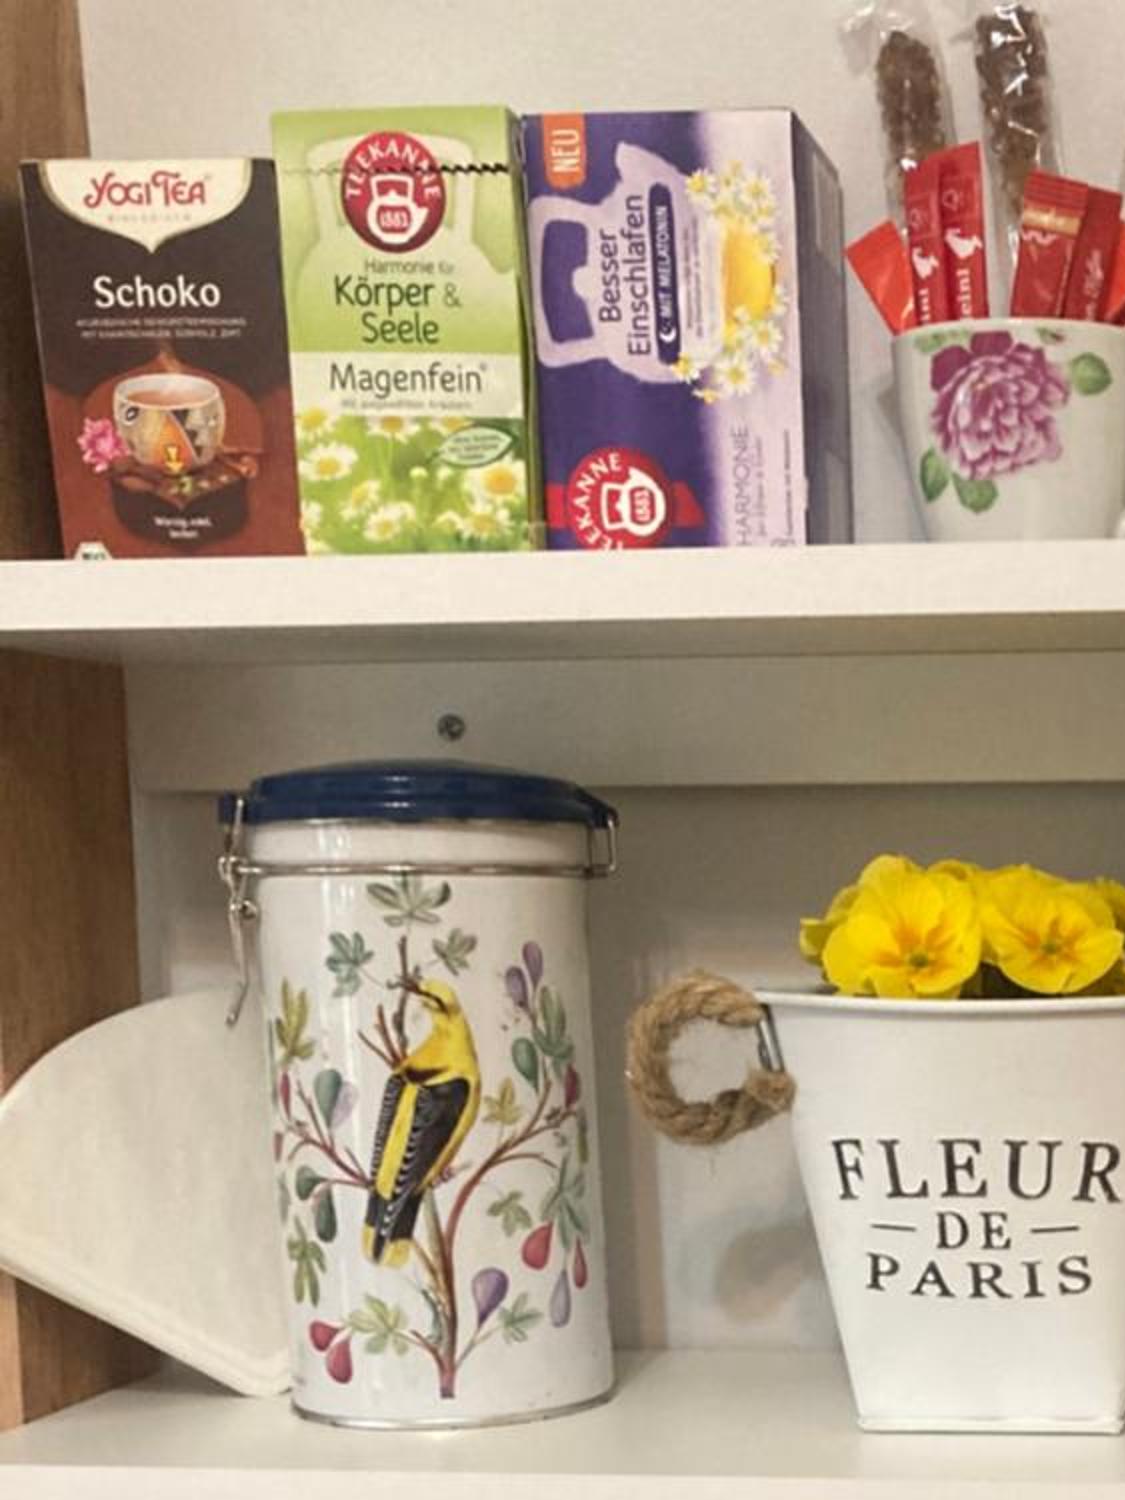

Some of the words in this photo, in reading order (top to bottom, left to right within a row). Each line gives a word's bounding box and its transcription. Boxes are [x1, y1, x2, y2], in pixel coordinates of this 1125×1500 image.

[344, 138, 442, 200] TEEKANNE
[551, 127, 581, 174] NEU
[83, 171, 152, 209] YOGI
[152, 170, 207, 206] TEA
[364, 258, 435, 273] Harmonie
[655, 205, 672, 288] MELATONIN
[93, 274, 221, 309] Schoko
[334, 275, 435, 314] Körper
[443, 283, 461, 308] &
[599, 229, 623, 324] Besser
[621, 194, 651, 357] Einschlafen
[657, 291, 673, 320] MIT
[362, 312, 442, 345] Seele
[329, 361, 483, 399] Magenfein
[831, 1137, 1123, 1204] FLEUR
[935, 1210, 1013, 1251] DE
[865, 1252, 1093, 1299] PARIS
